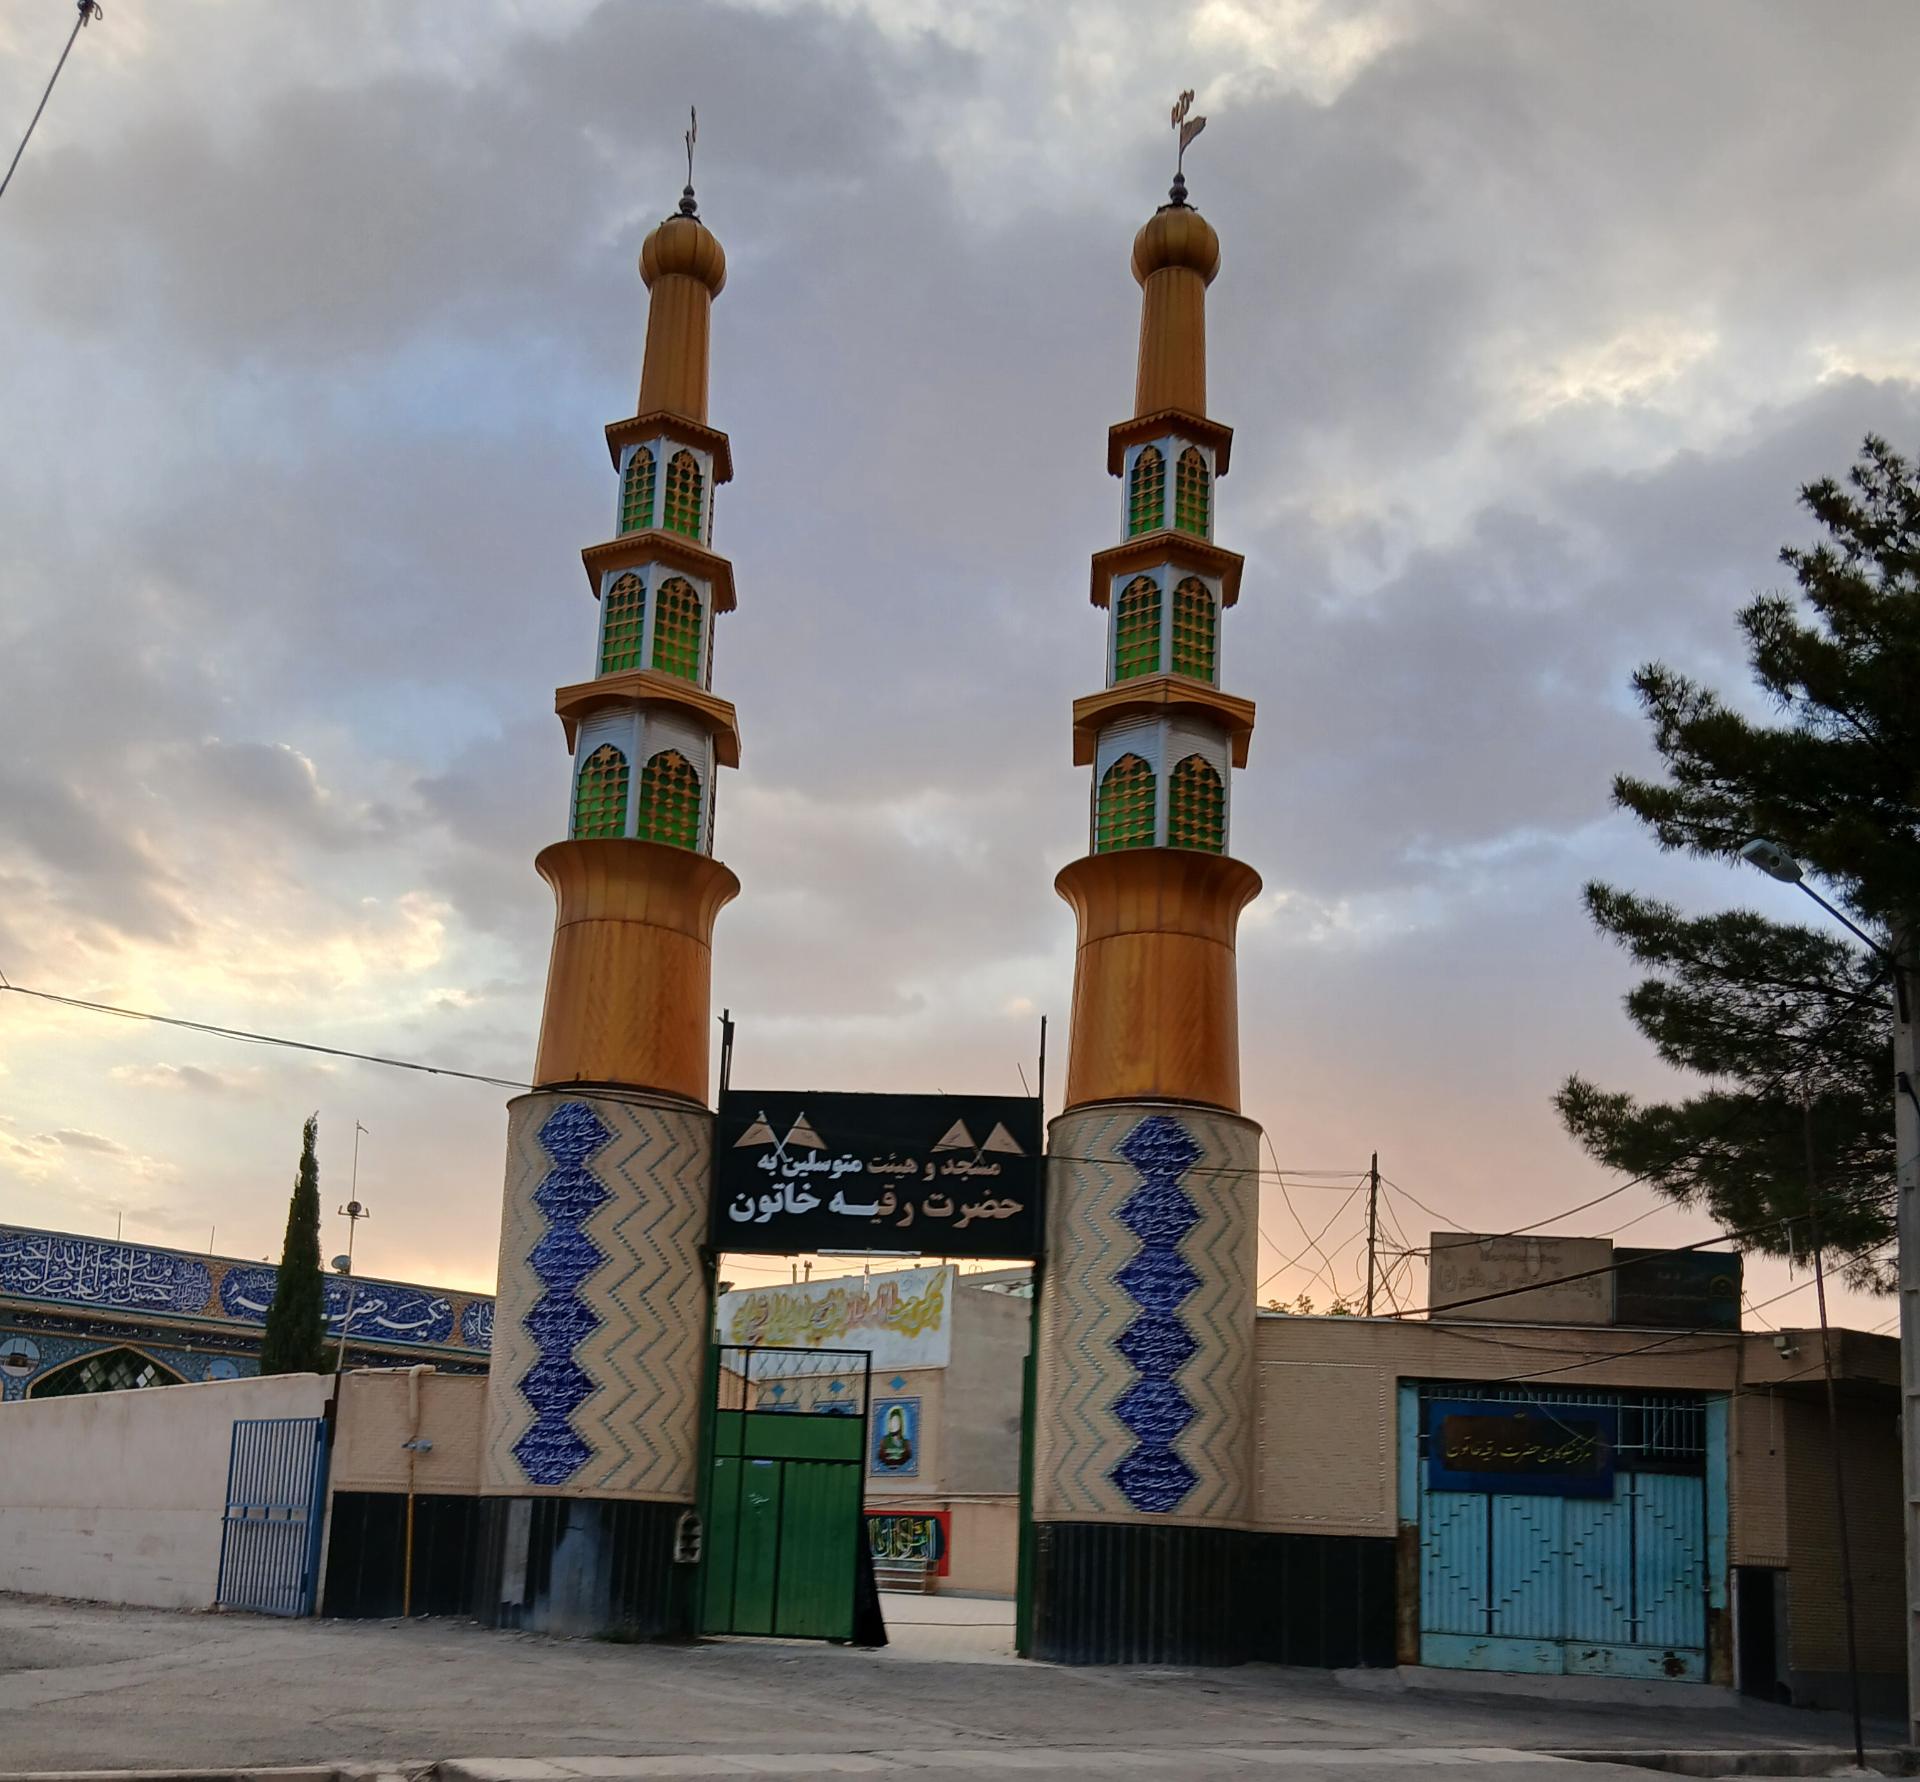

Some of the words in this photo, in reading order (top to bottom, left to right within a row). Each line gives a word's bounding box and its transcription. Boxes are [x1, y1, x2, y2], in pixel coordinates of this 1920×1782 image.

[757, 1153, 778, 1176] به
[782, 1150, 863, 1179] متوسلین
[867, 1152, 918, 1179] هیئت
[923, 1158, 937, 1181] و
[940, 1157, 1001, 1181] مسجد
[728, 1182, 822, 1223] خاتون
[828, 1184, 914, 1227] رقیه
[922, 1189, 1025, 1228] حضرت
[1499, 1443, 1541, 1464] حضرت
